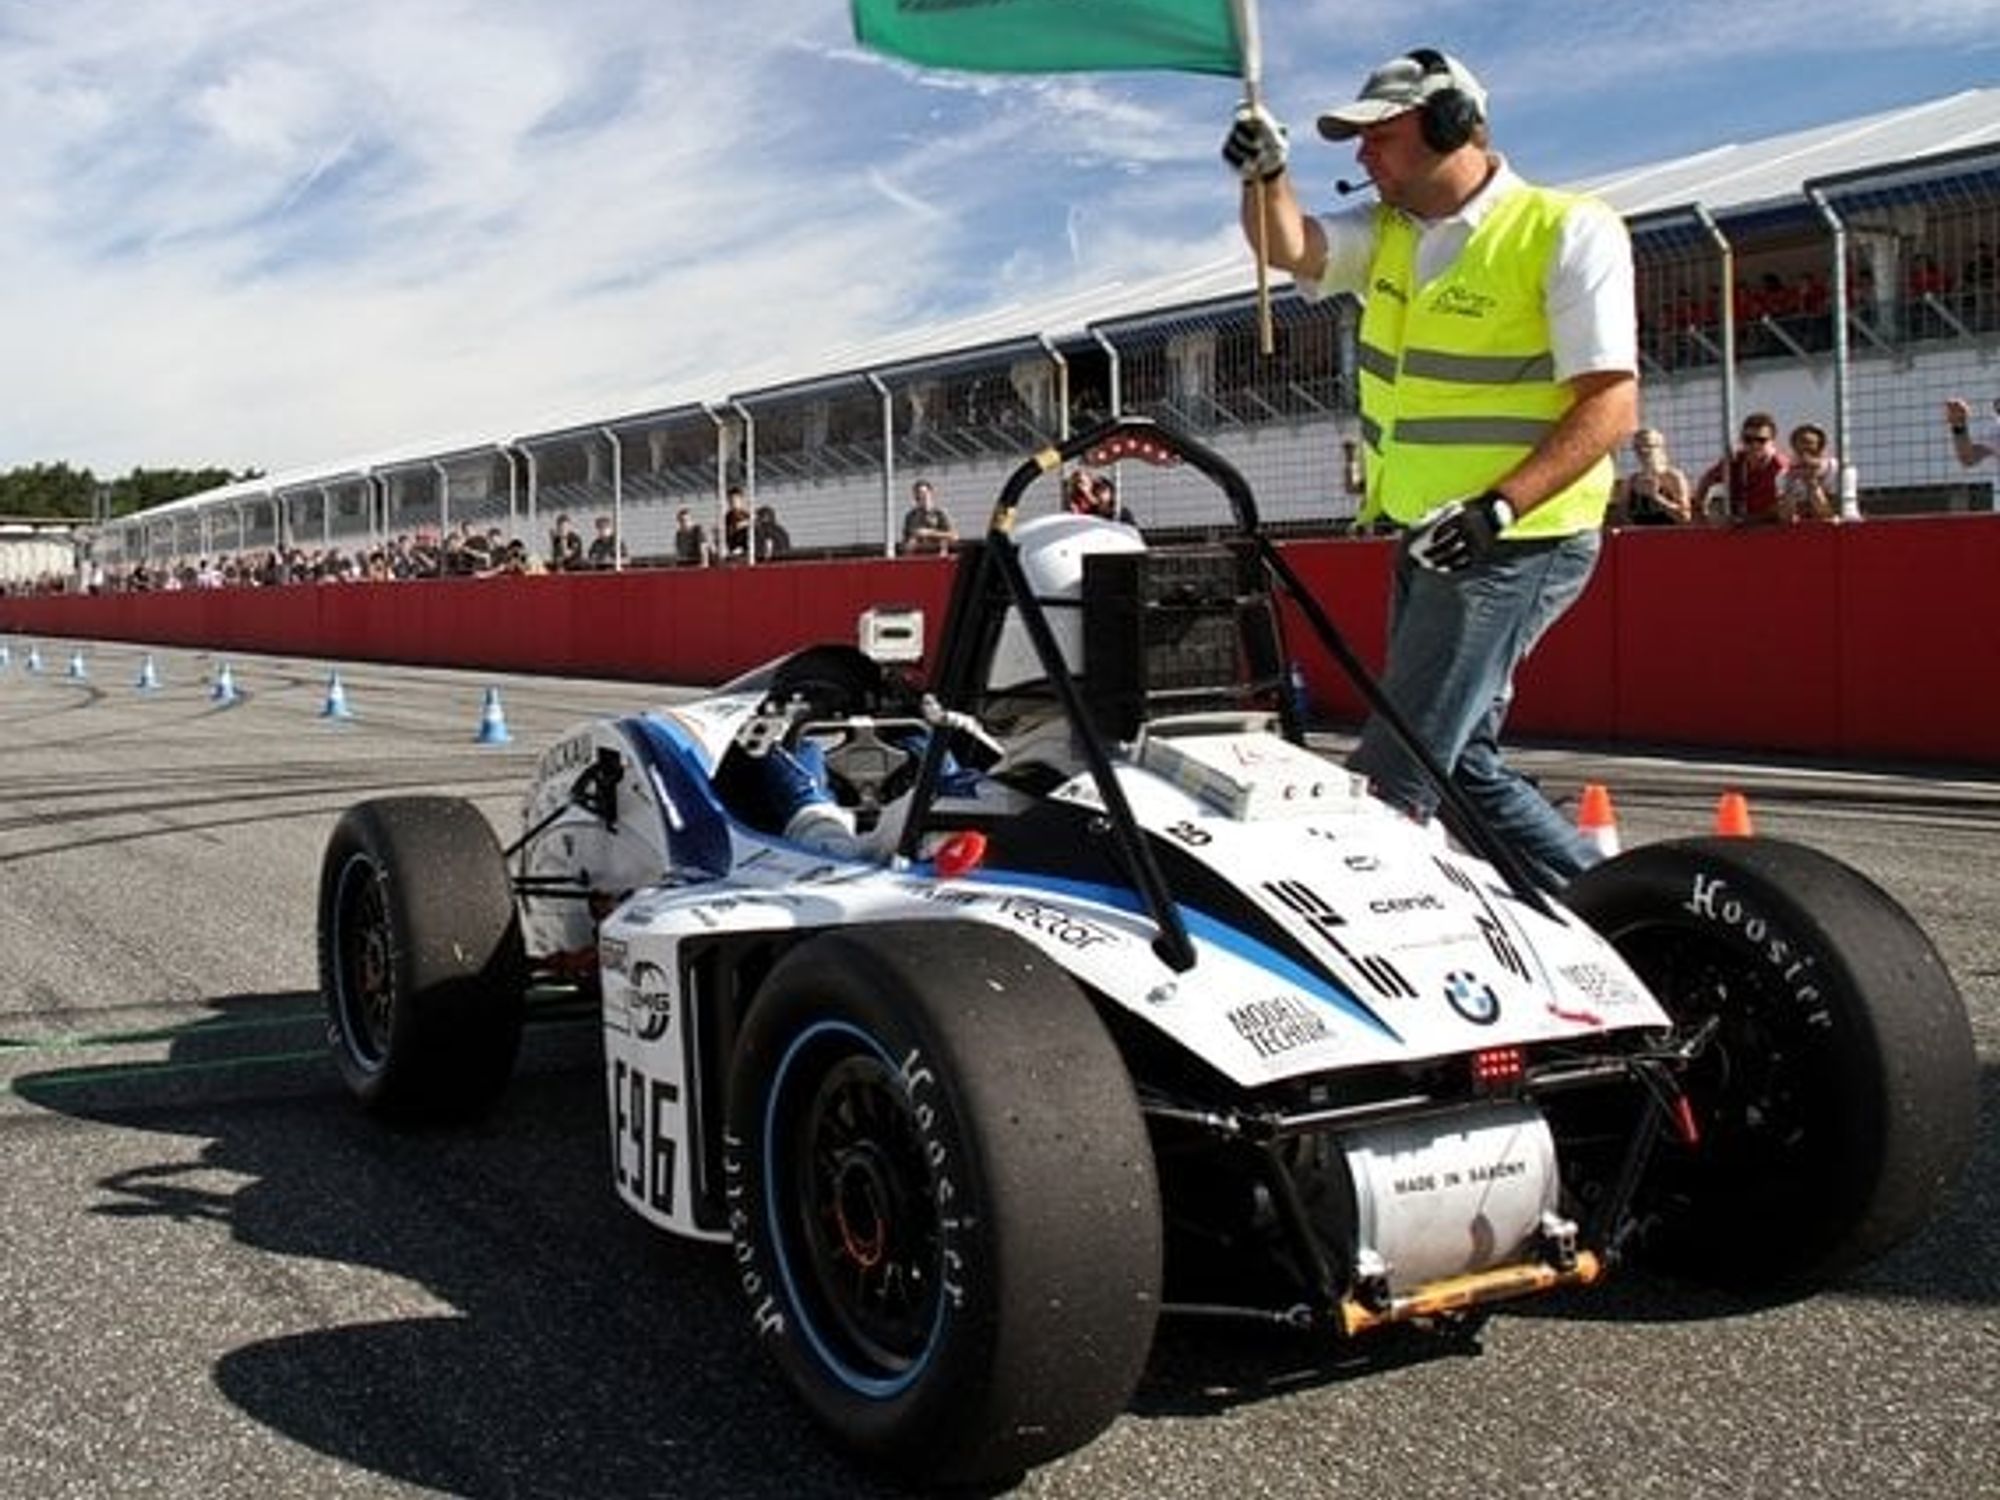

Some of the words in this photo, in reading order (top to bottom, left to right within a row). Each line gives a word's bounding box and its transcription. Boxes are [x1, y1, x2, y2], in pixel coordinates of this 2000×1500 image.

[615, 1056, 679, 1218] E96
[1394, 1173, 1437, 1195] MADE
[1443, 1169, 1461, 1186] IN
